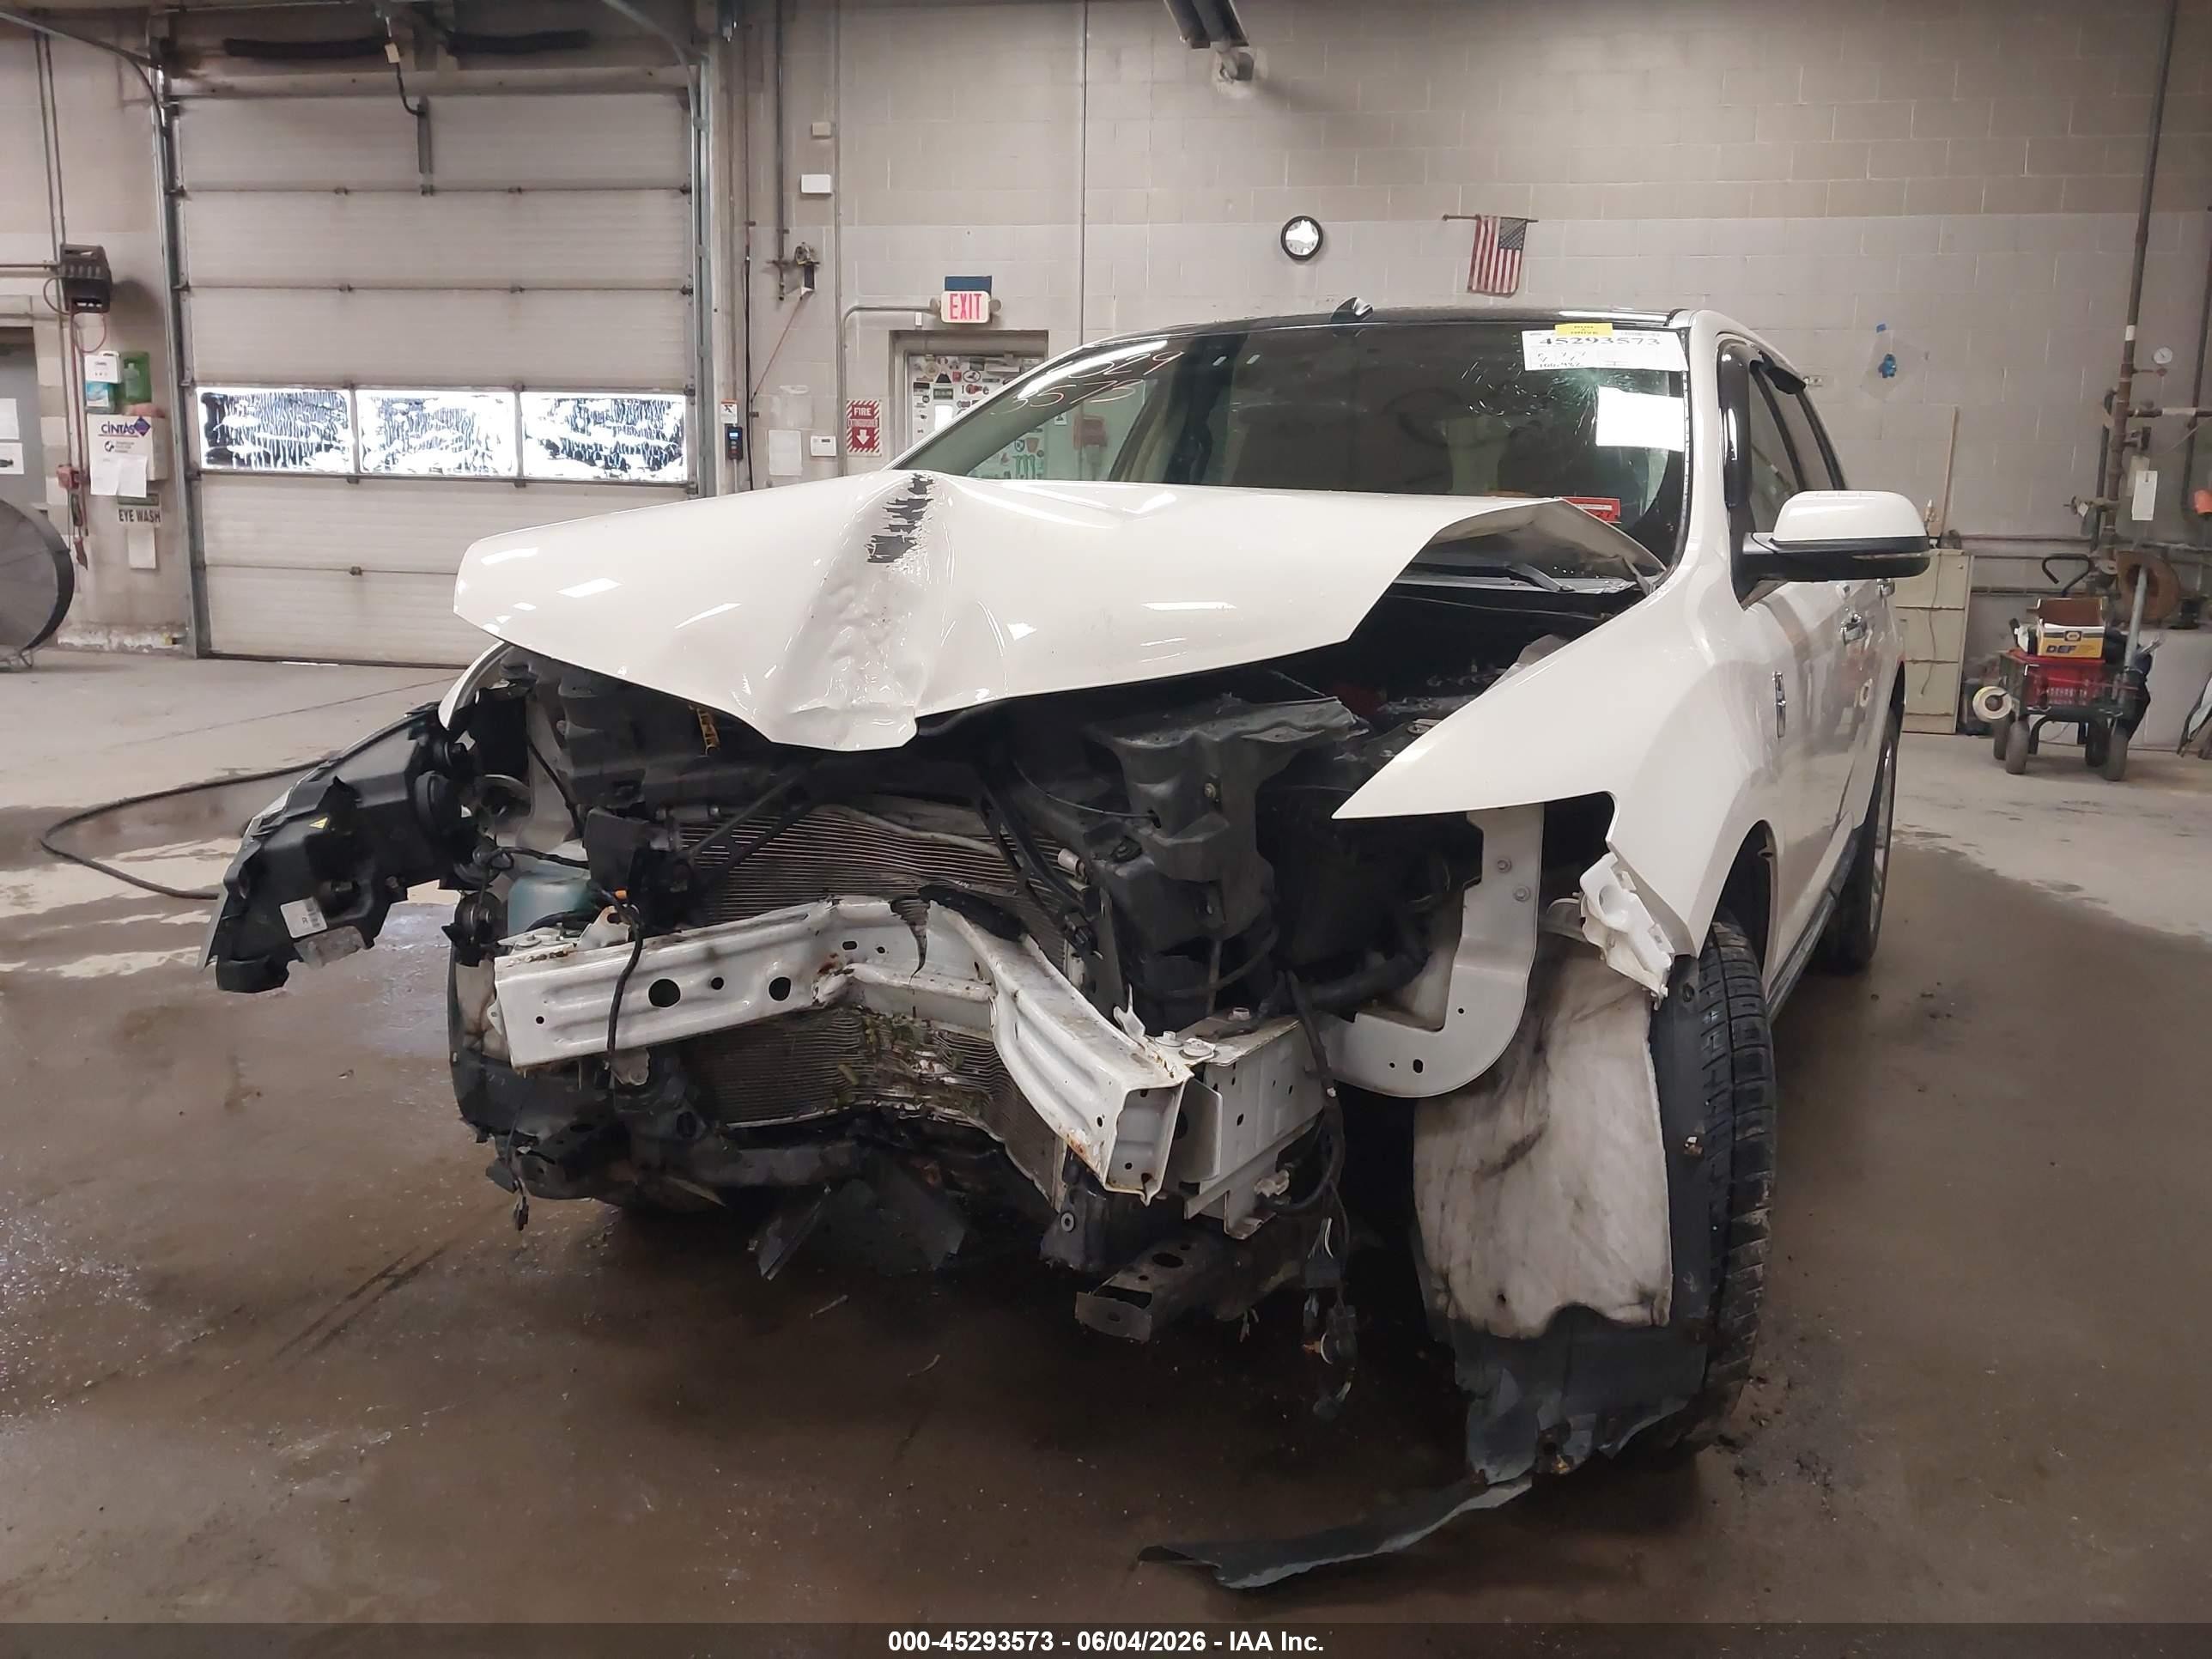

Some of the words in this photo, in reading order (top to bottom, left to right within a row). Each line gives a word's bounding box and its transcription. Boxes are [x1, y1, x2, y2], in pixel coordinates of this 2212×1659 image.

[949, 293, 982, 320] EXIT
[854, 407, 872, 416] FIRE
[118, 508, 134, 523] EYE
[136, 508, 161, 523] WASH
[2045, 645, 2076, 653] DEF
